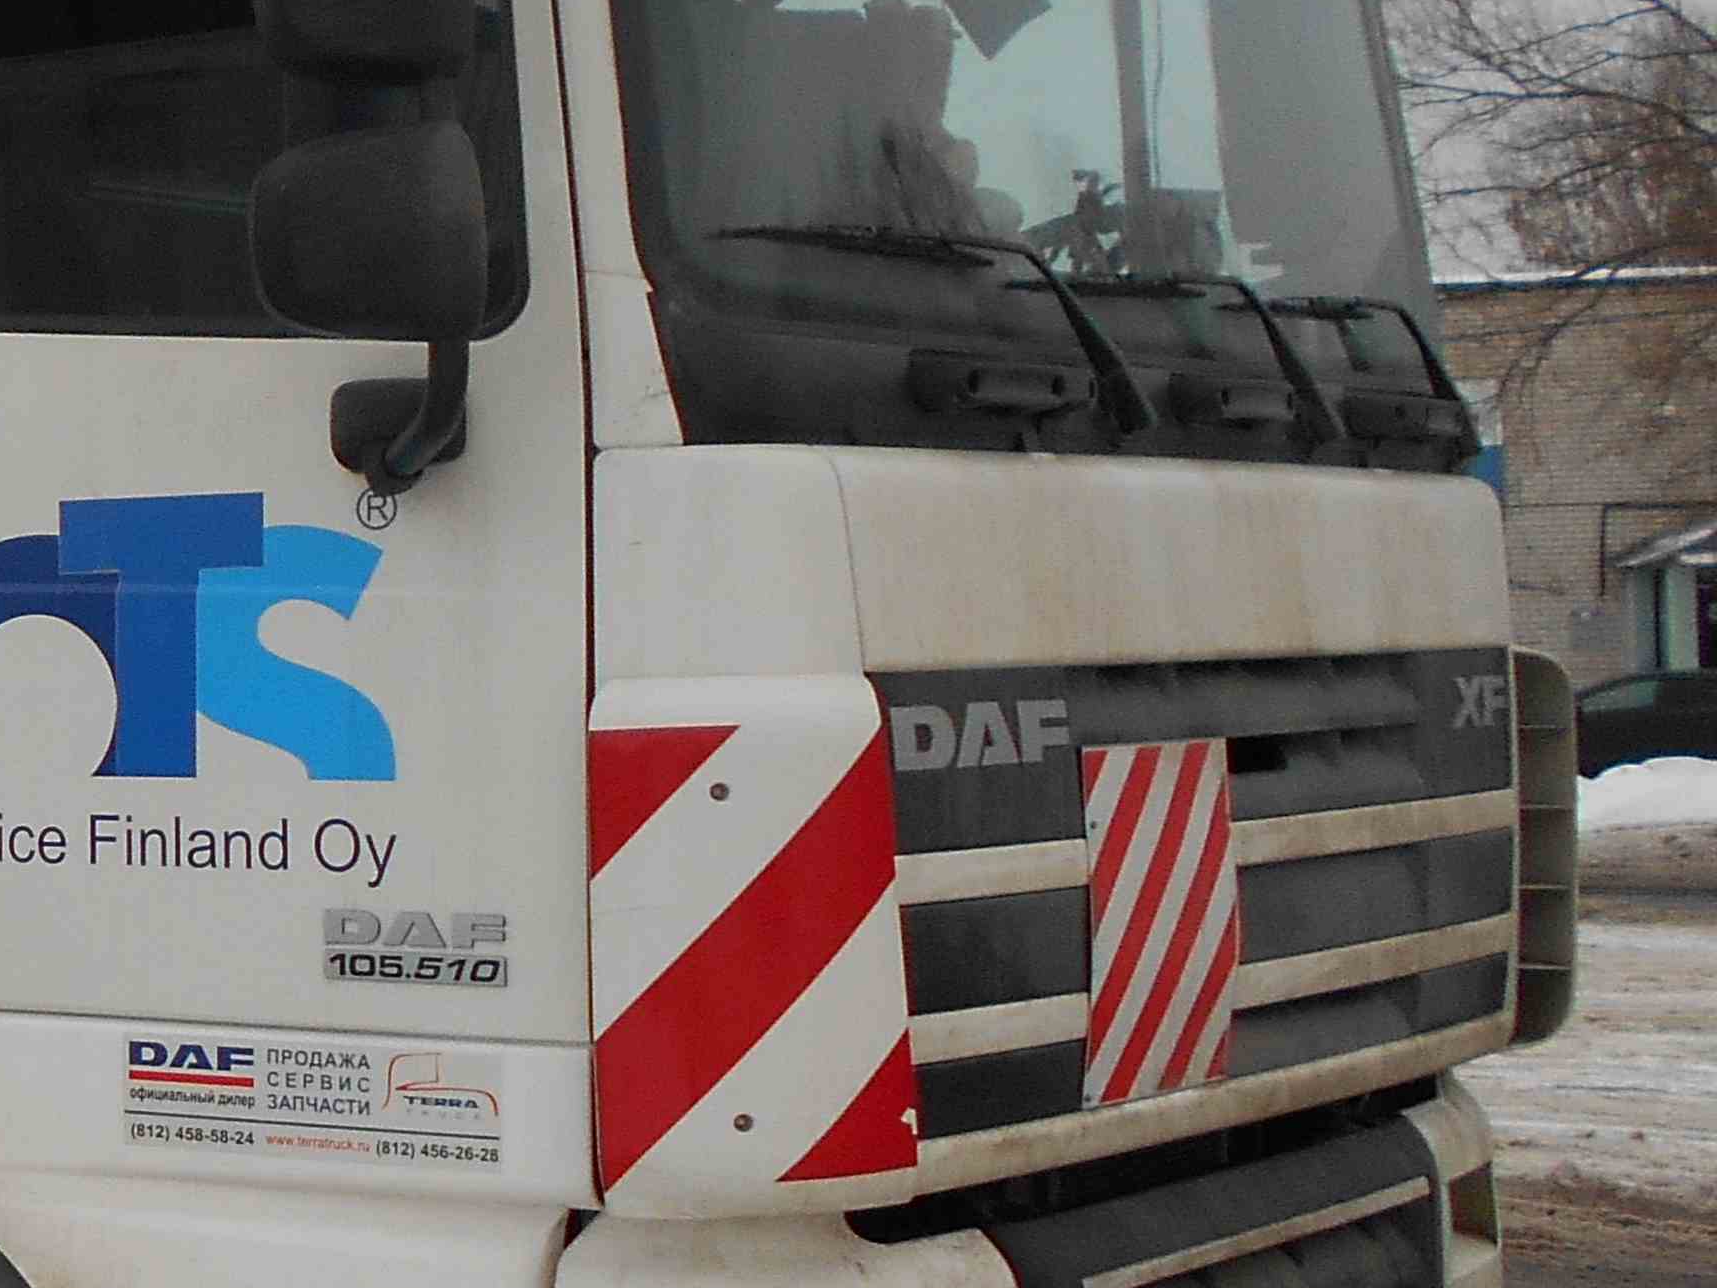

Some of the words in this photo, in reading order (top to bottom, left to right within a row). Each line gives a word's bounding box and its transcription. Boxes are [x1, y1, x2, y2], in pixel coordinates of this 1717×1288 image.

[1452, 675, 1507, 729] XF
[890, 700, 1070, 771] DAF
[88, 814, 289, 870] Finland
[315, 819, 398, 887] Oy
[325, 909, 506, 949] DAF
[329, 952, 501, 983] 105.510
[129, 1041, 254, 1071] DAF
[267, 1048, 371, 1070] ПРОДАЖА
[267, 1071, 371, 1092] СЕРВИС
[129, 1087, 215, 1104] официальный
[218, 1093, 255, 1109] дилер
[267, 1094, 371, 1116] ЗАПЧАСТИ
[404, 1095, 480, 1109] TERRA
[131, 1122, 170, 1142] (812)
[175, 1126, 255, 1145] 458-58-24
[265, 1134, 372, 1153] www.terratruck.ru
[376, 1139, 415, 1159] (812)
[420, 1142, 500, 1163] 456-26-28
